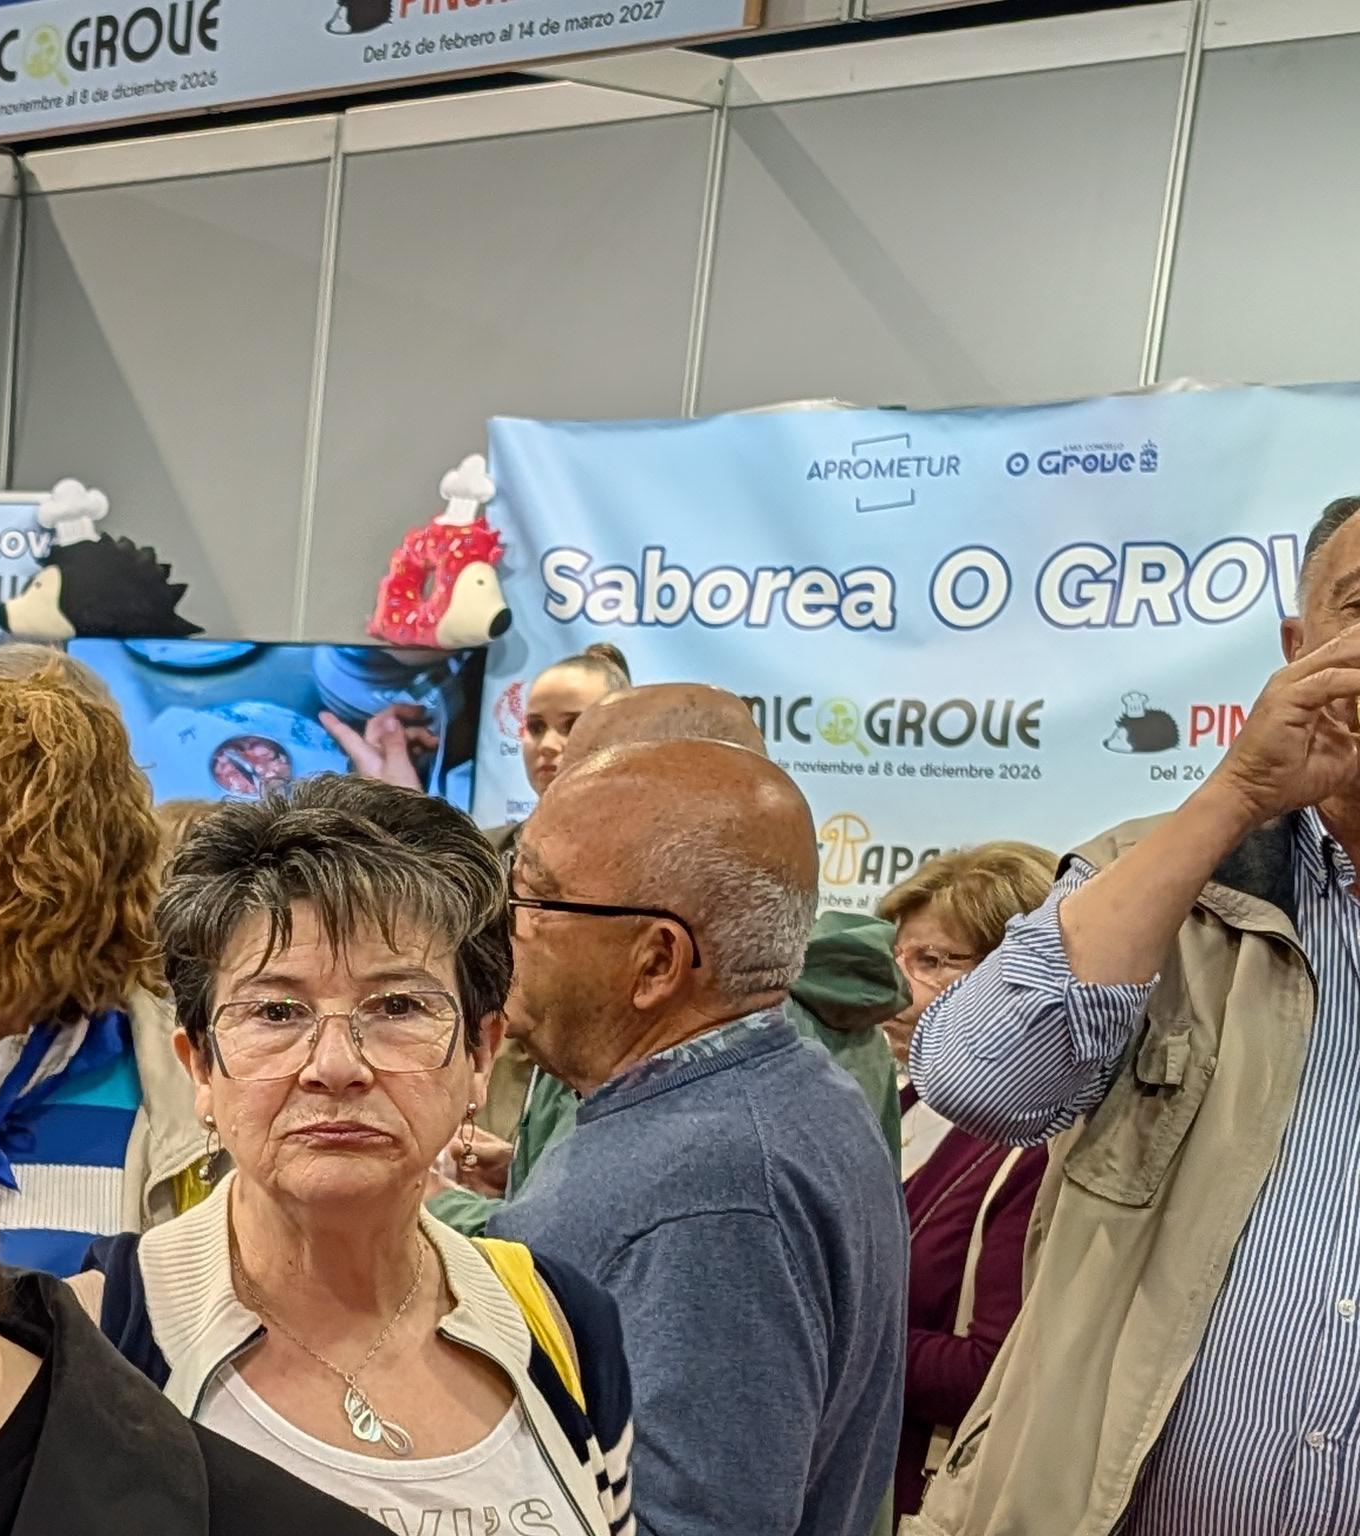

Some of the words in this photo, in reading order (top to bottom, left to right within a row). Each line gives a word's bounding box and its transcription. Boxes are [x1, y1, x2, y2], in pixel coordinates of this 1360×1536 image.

[363, 45, 388, 63] Del
[390, 42, 413, 59] 26
[415, 37, 435, 55] de
[438, 28, 497, 51] febrero
[499, 24, 514, 43] al
[518, 20, 535, 41] 14
[538, 17, 561, 37] de
[564, 13, 615, 33] marzo
[617, 0, 667, 24] 2027
[65, 91, 78, 107] al
[91, 86, 109, 102] de
[111, 78, 177, 99] diciembre
[179, 71, 219, 91] 2026
[805, 455, 962, 481] APROMETUR
[1005, 452, 1030, 478] O
[540, 545, 897, 632] Saborea
[928, 544, 1014, 632] O
[793, 758, 864, 776] noviembre
[867, 759, 880, 776] al
[883, 760, 893, 776] 8
[896, 761, 916, 777] de
[919, 760, 995, 779] diciembre
[998, 764, 1042, 780] 2026
[1150, 765, 1177, 781] Del
[1182, 765, 1205, 781] 26
